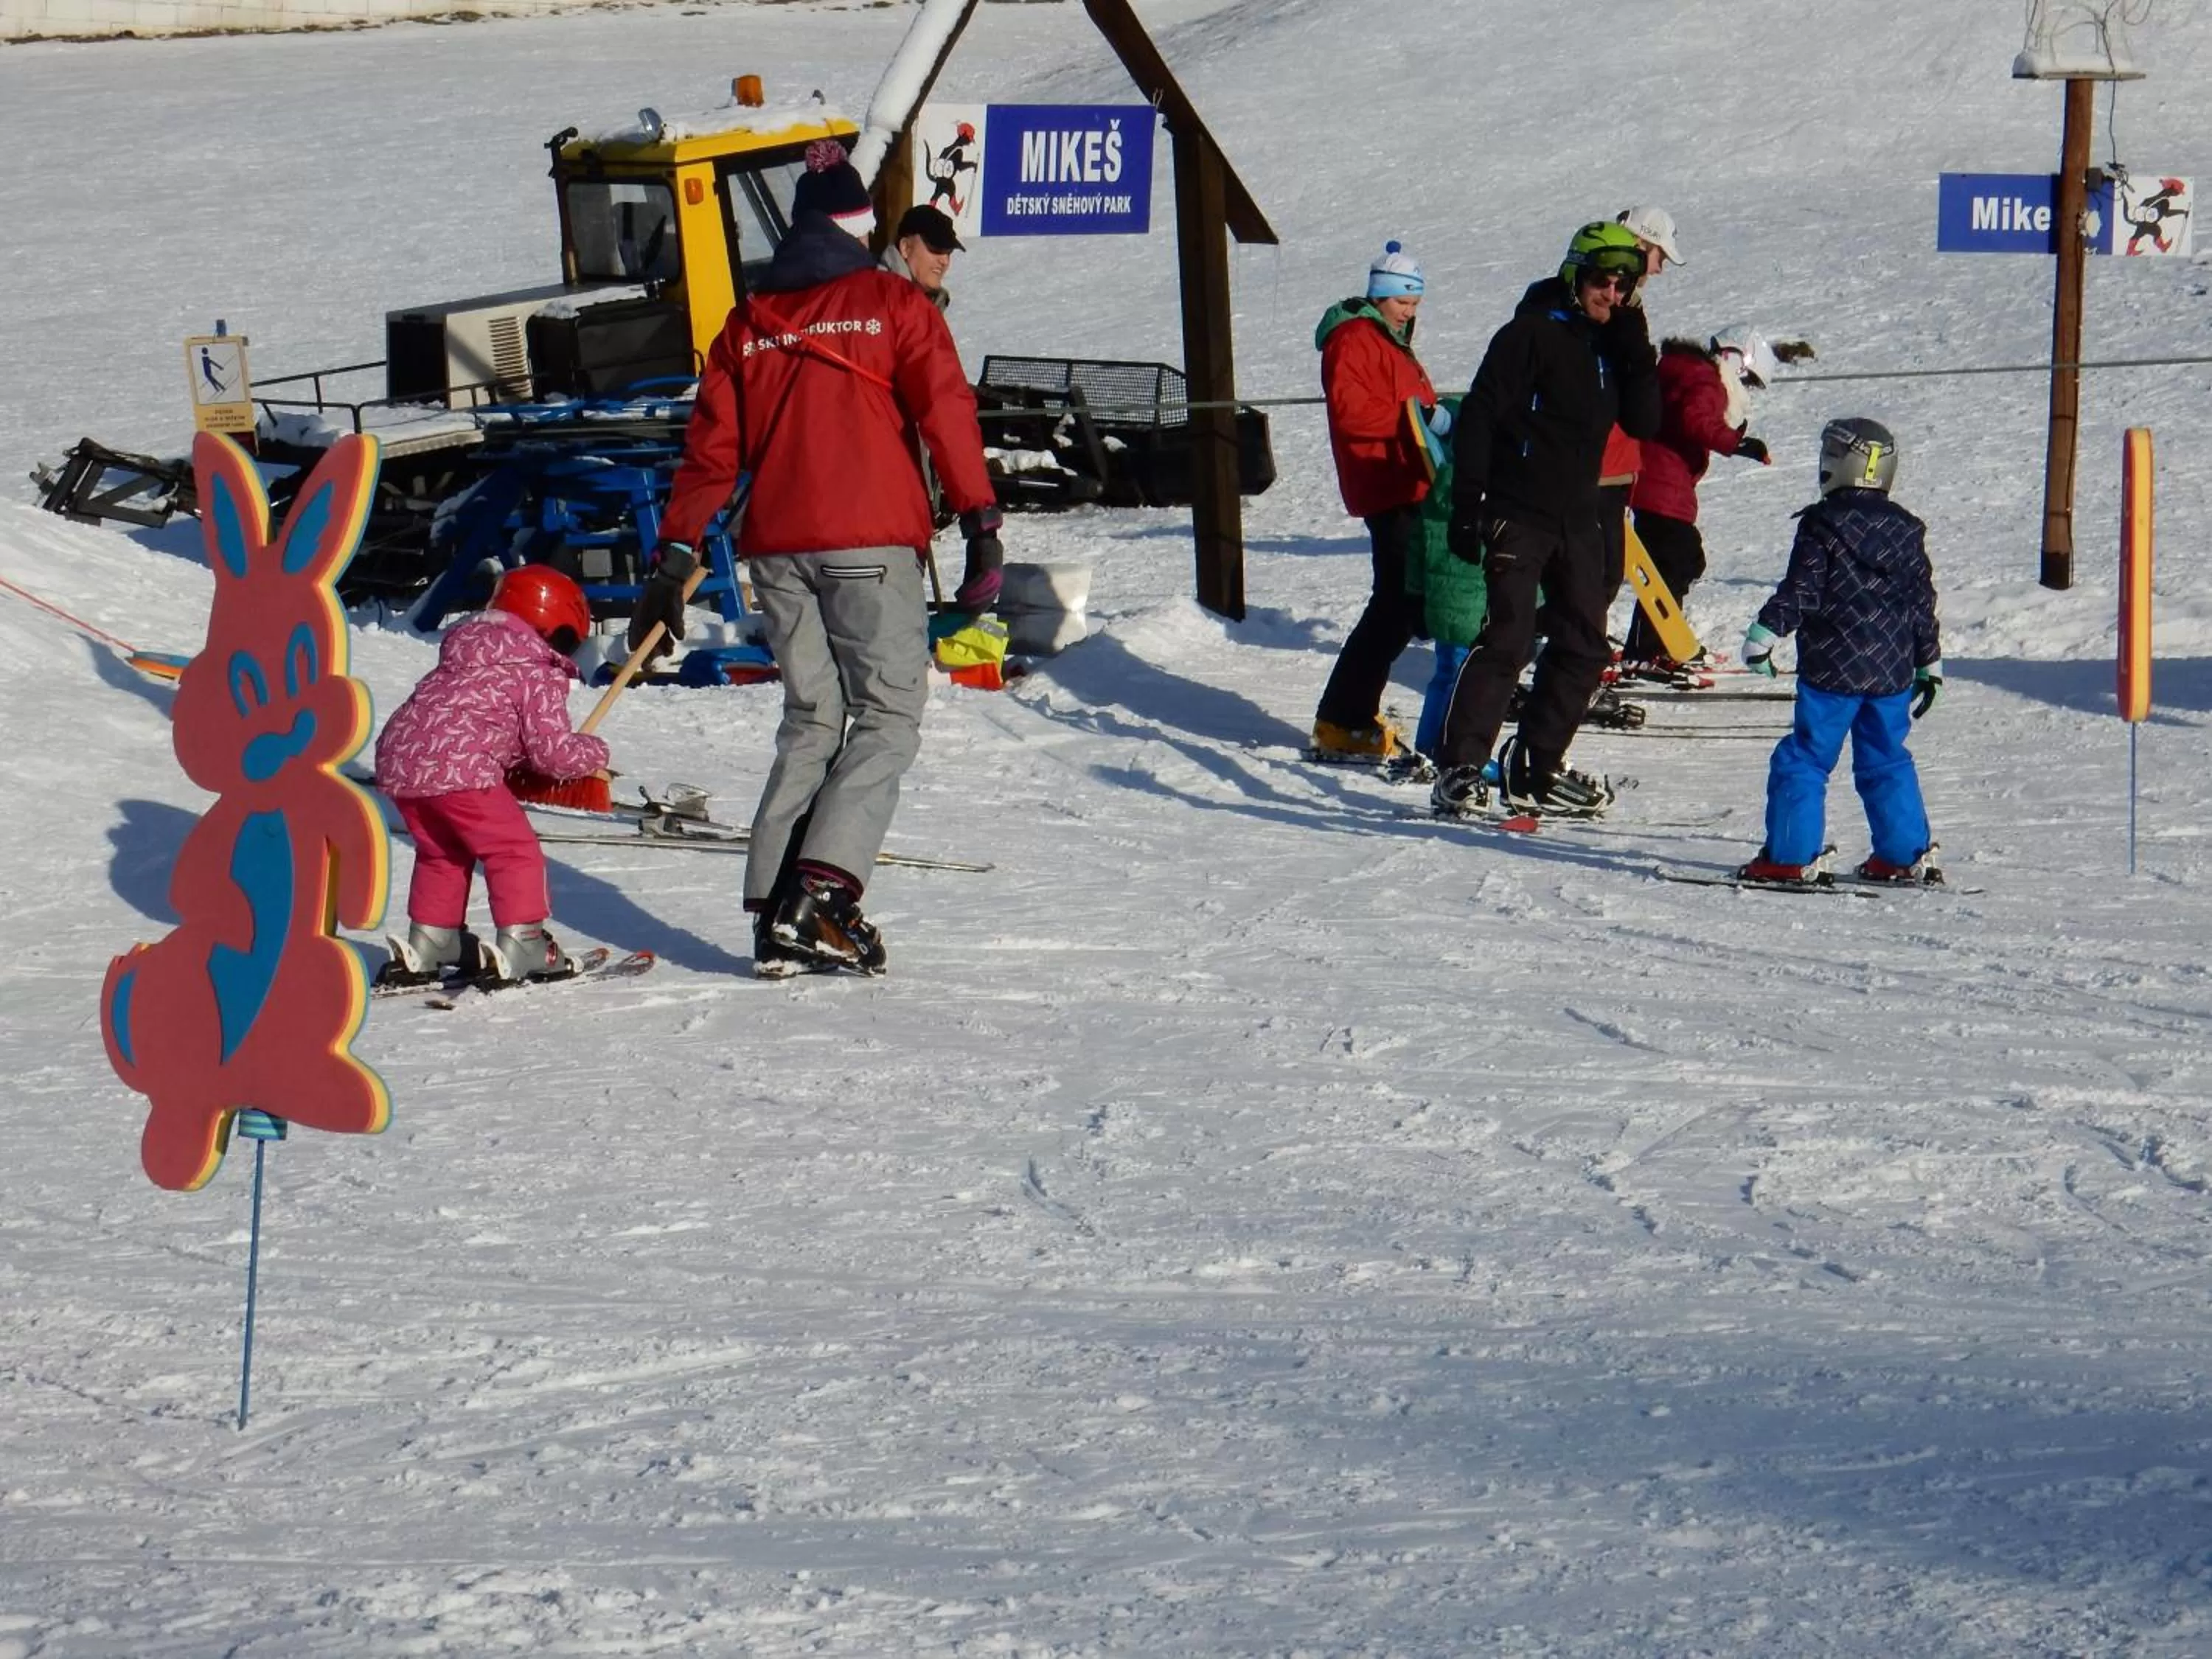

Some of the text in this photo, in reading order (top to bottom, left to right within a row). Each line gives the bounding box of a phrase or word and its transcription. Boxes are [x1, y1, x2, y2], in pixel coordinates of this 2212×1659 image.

[1021, 119, 1121, 183] MIKEŠ
[1104, 195, 1132, 214] PARK
[1972, 197, 2052, 231] Mike
[757, 320, 862, 350] SKI INRUKTOR
